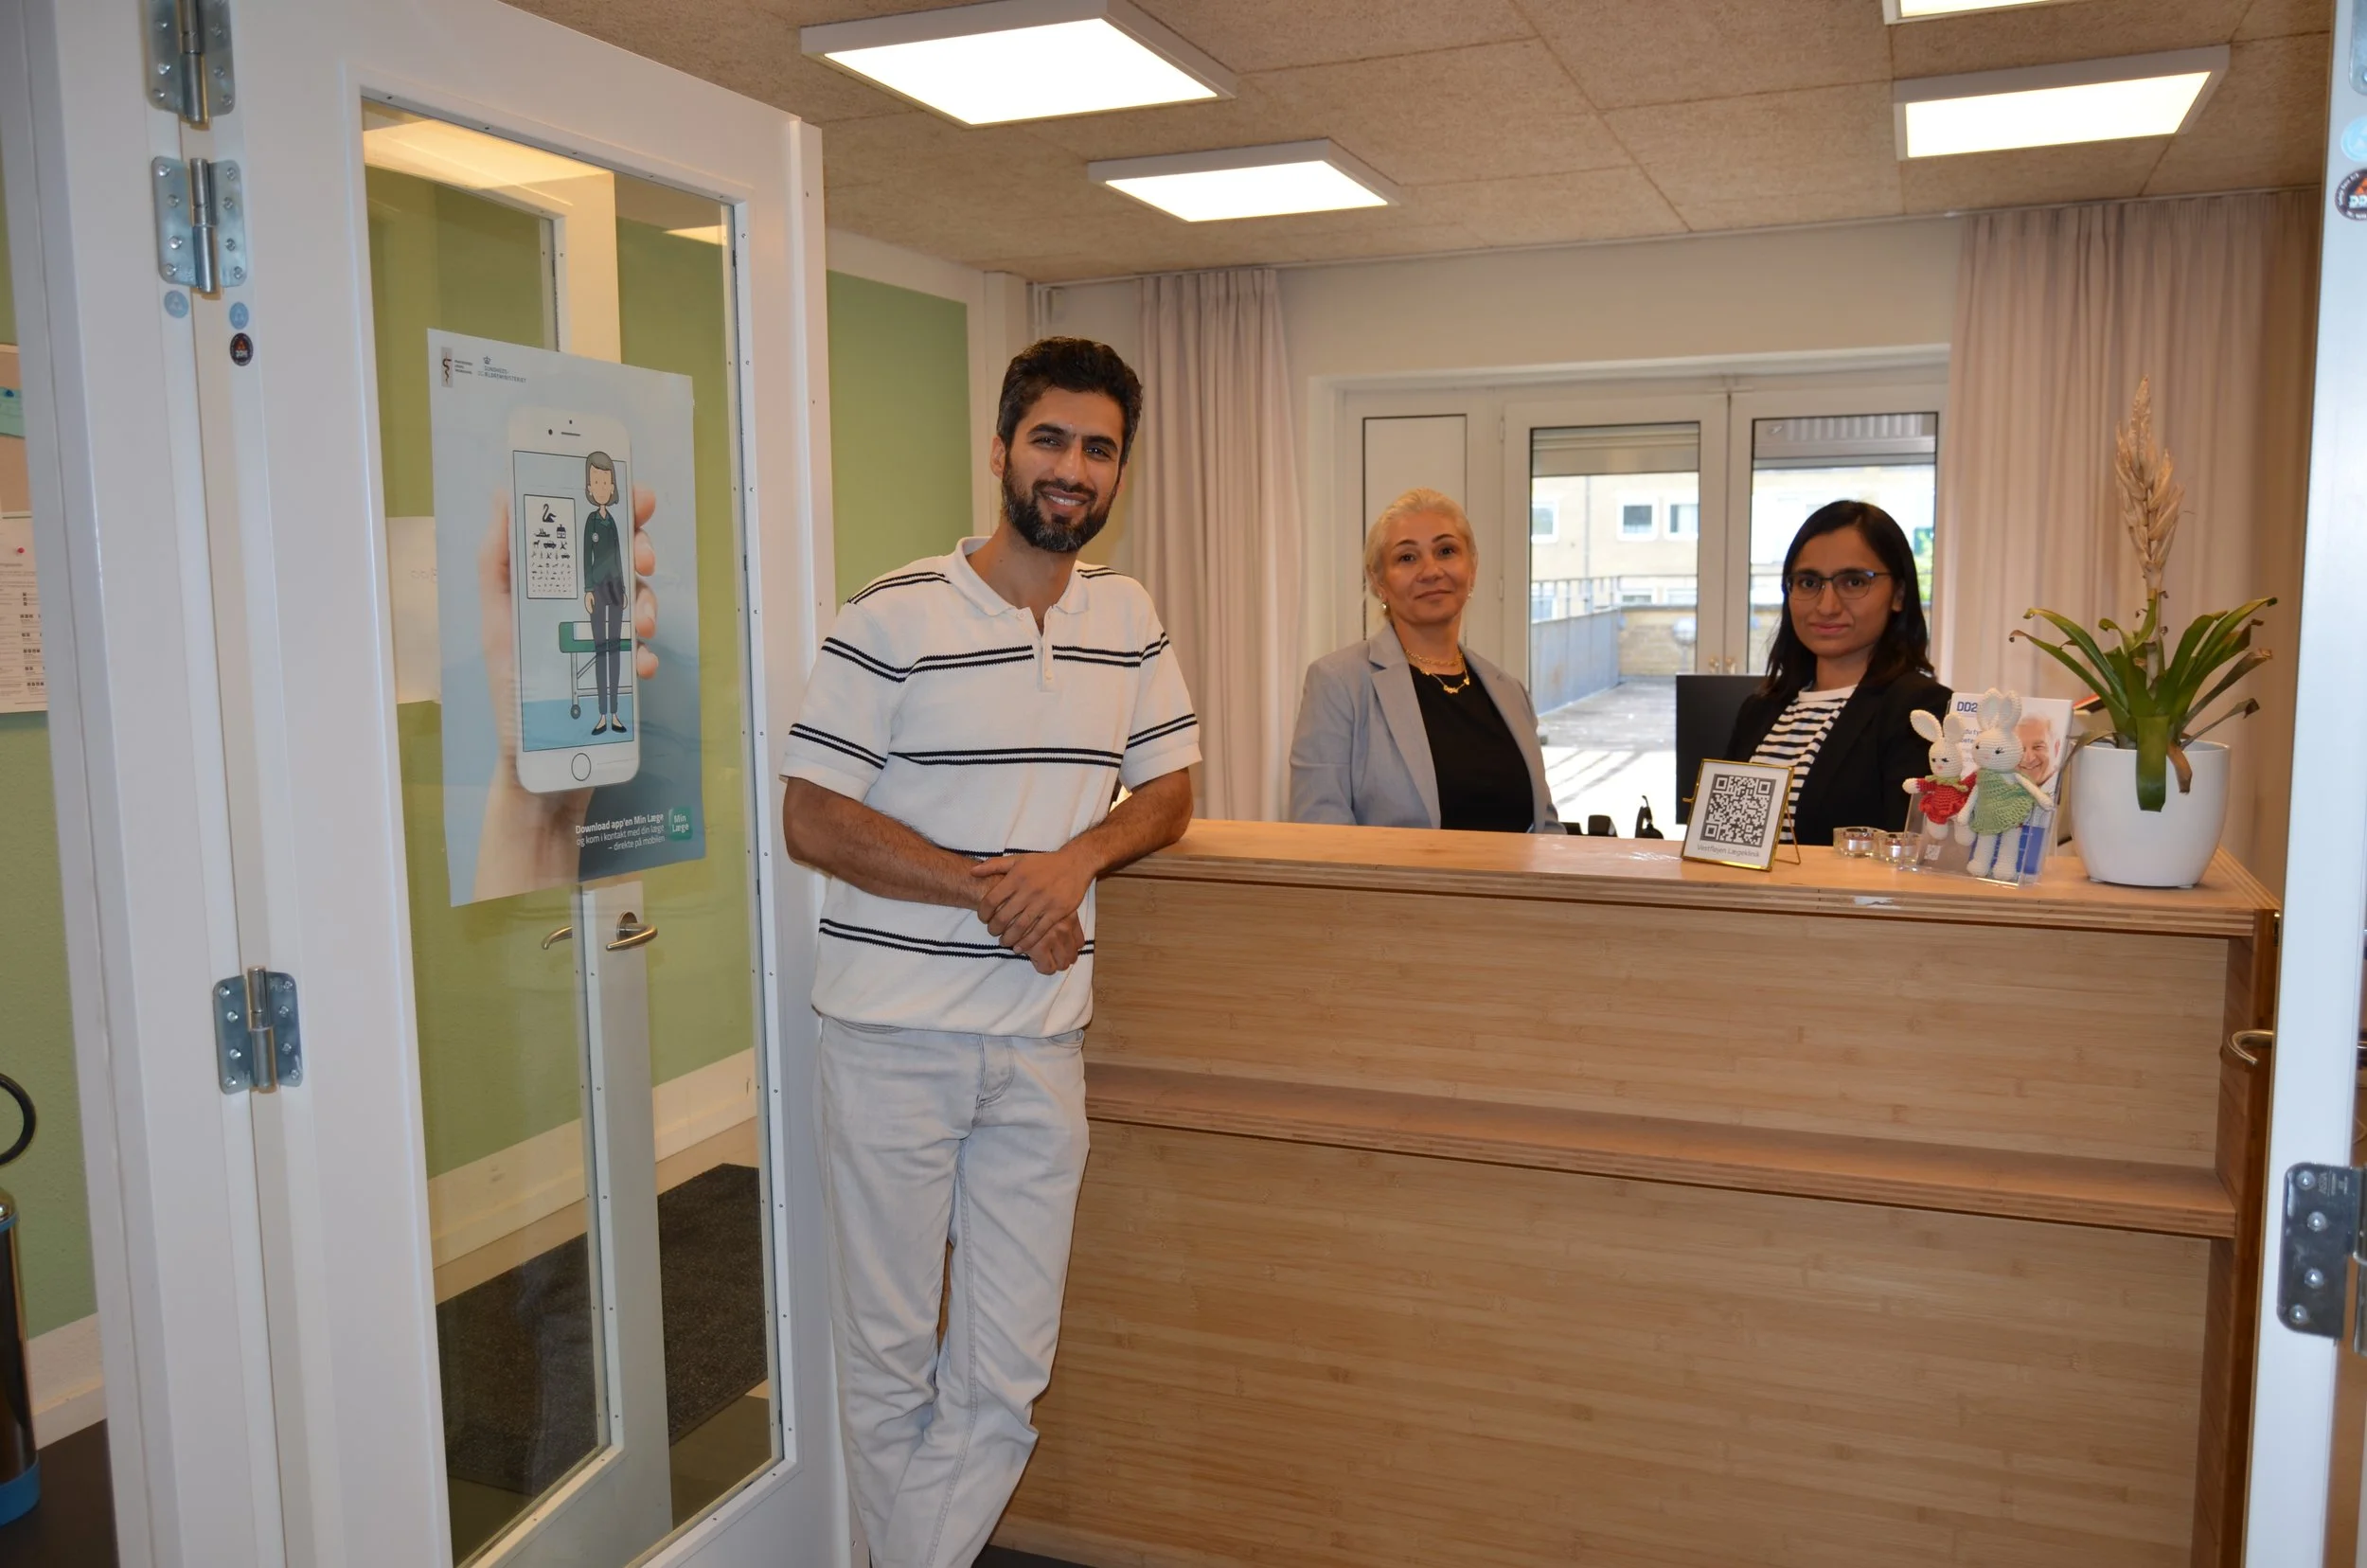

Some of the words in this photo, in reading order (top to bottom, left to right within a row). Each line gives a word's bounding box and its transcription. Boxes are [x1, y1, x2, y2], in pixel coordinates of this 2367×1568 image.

[1957, 702, 1978, 712] DD2
[576, 821, 610, 834] Download
[611, 818, 632, 831] app'en
[634, 816, 646, 825] Min
[647, 813, 664, 824] Læge
[674, 814, 686, 823] Min
[671, 823, 689, 833] Læge
[576, 838, 585, 847] og
[585, 834, 600, 846] kom
[603, 829, 627, 842] kontakt
[627, 827, 640, 837] med
[640, 826, 650, 835] din
[650, 824, 665, 834] læge
[614, 840, 634, 850] direkte
[634, 838, 642, 849] på
[642, 835, 666, 846] mobilen
